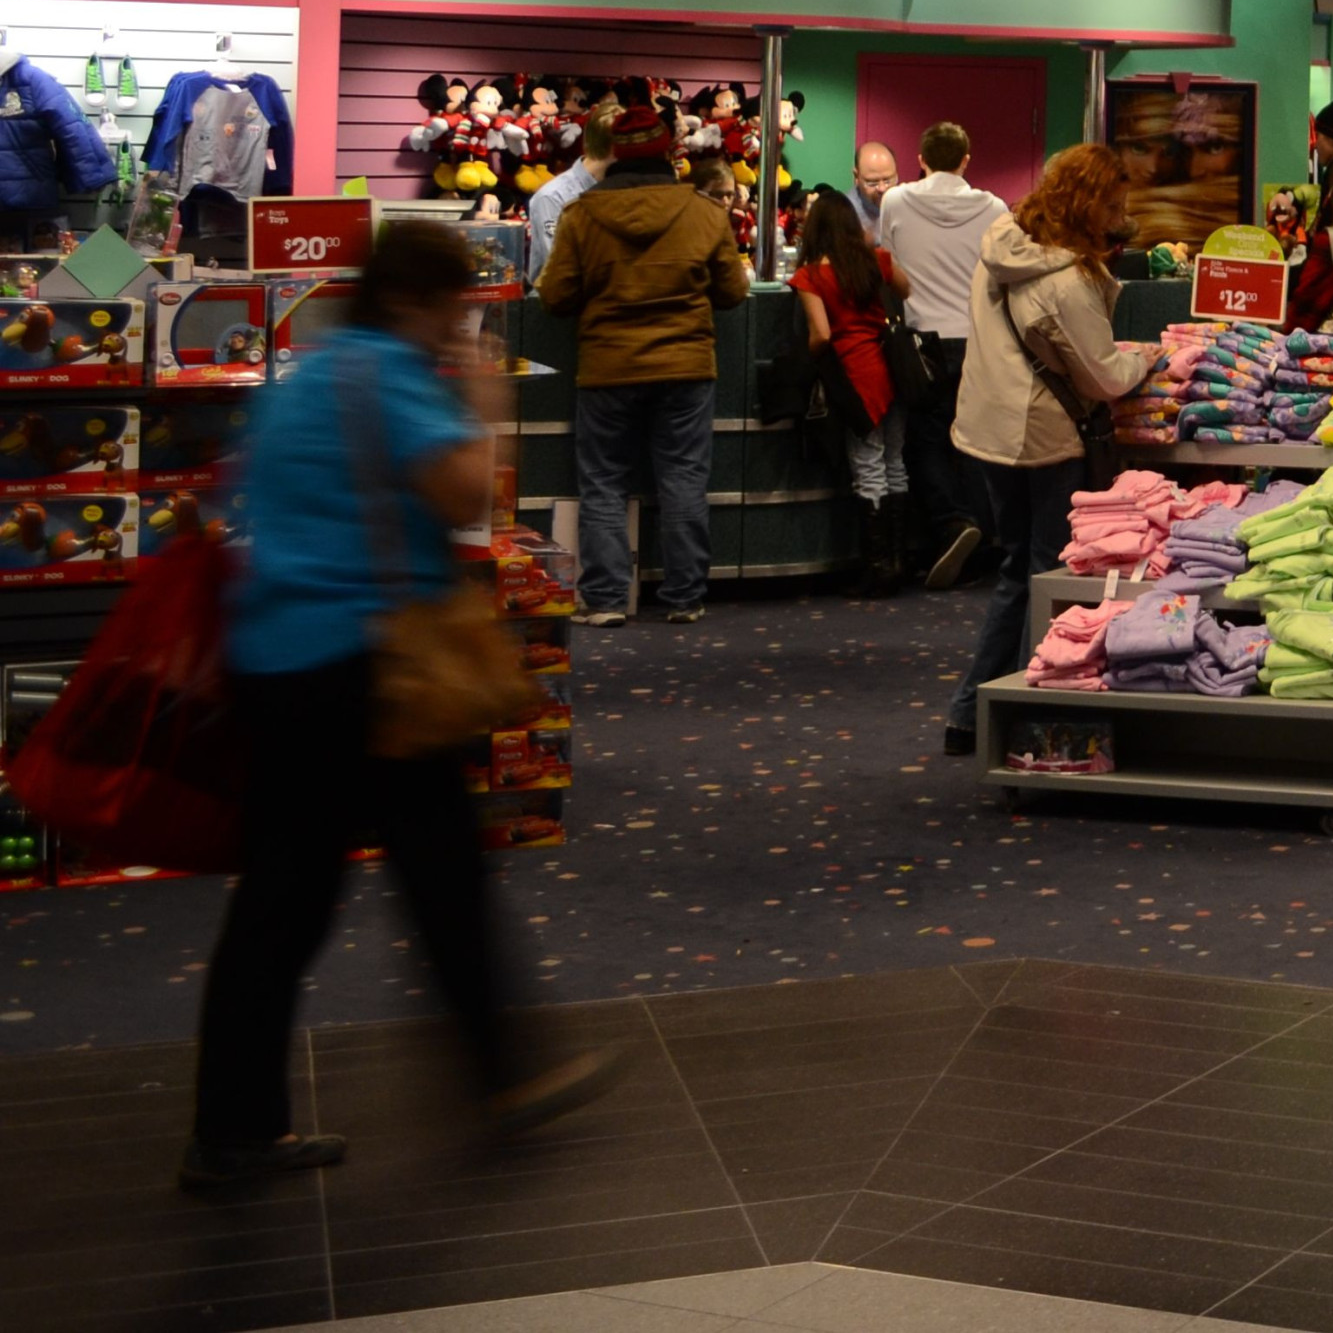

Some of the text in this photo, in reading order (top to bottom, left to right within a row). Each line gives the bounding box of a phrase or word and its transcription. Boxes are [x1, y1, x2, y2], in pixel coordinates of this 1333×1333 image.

[268, 216, 289, 224] Toys
[49, 374, 70, 382] DOG
[46, 482, 67, 491] DOG
